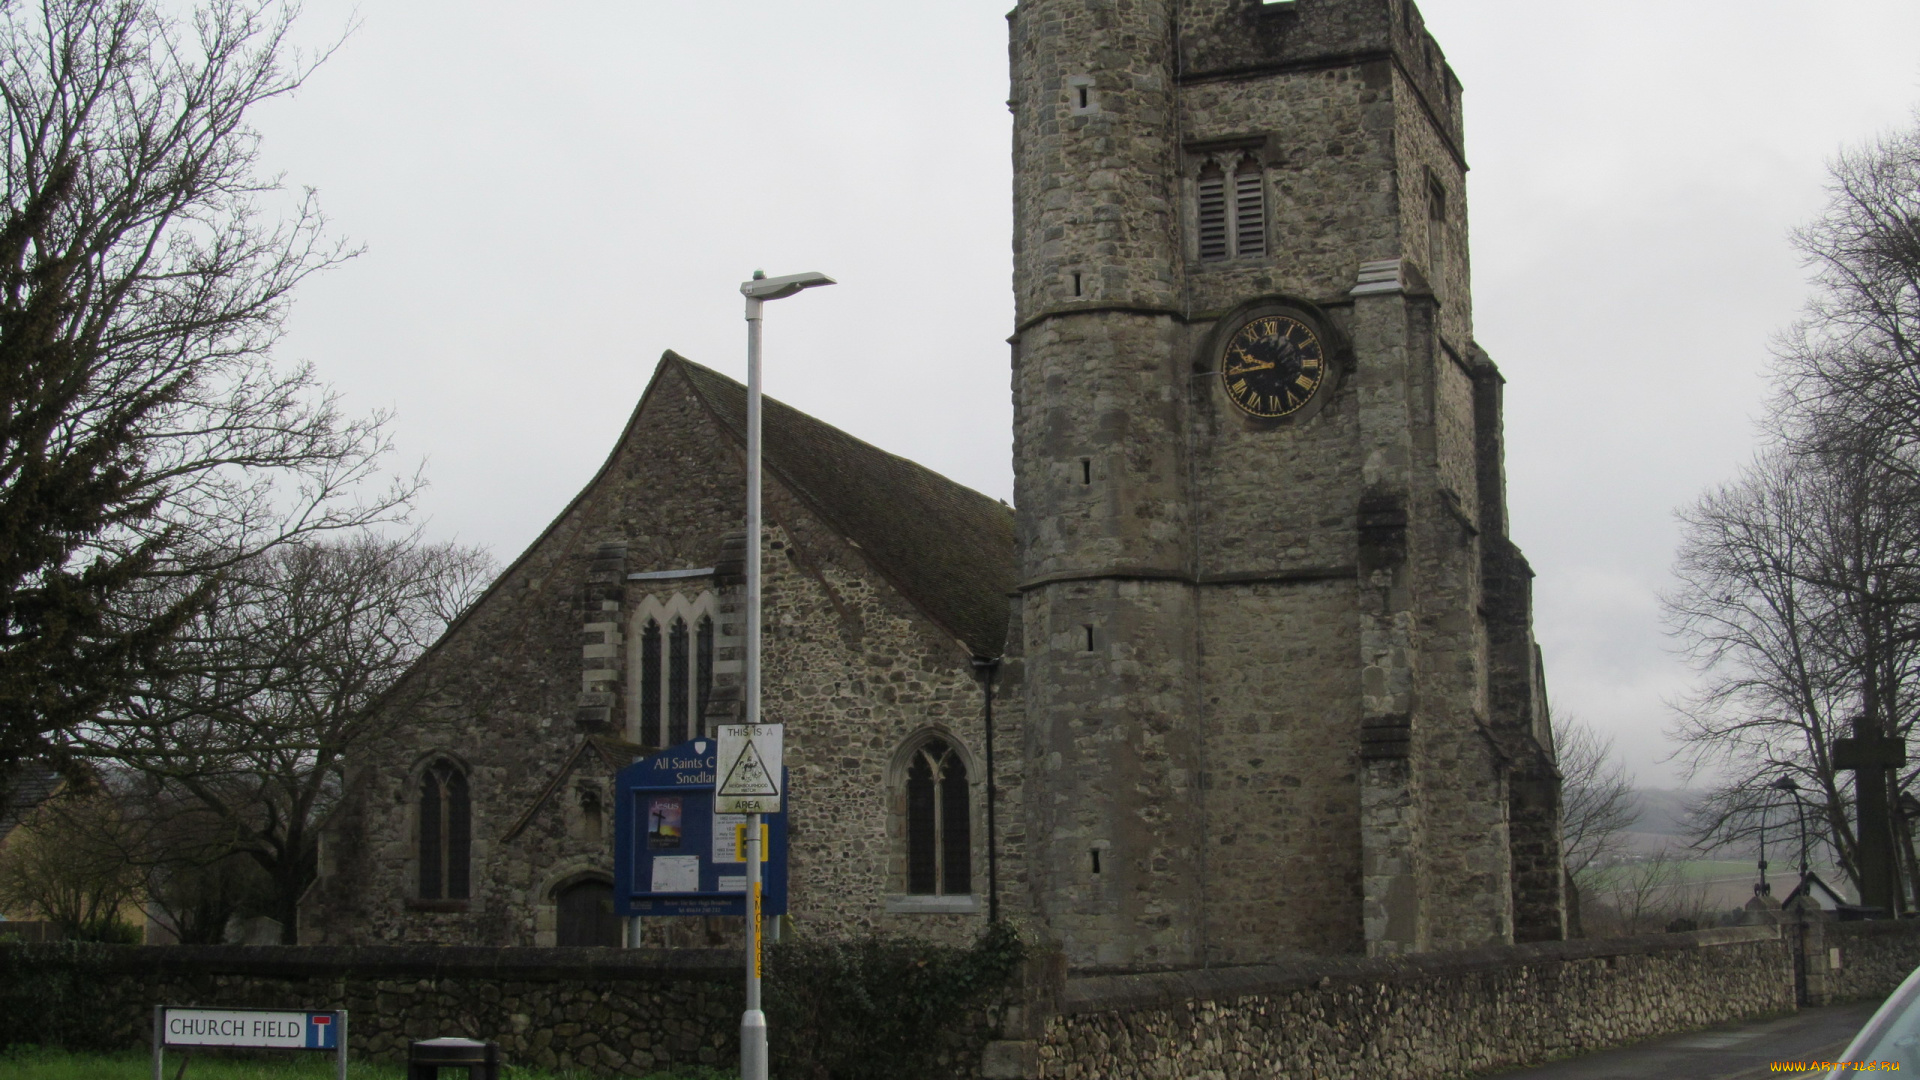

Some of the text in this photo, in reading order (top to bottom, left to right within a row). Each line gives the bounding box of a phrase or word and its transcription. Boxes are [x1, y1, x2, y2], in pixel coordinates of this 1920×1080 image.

[1264, 322, 1278, 335] XII
[727, 727, 773, 736] THIS IS A
[655, 758, 669, 770] All
[672, 757, 703, 770] Saints
[653, 800, 679, 810] Jesus
[735, 800, 760, 809] AREA
[170, 1018, 301, 1038] CHURCH FIELD
